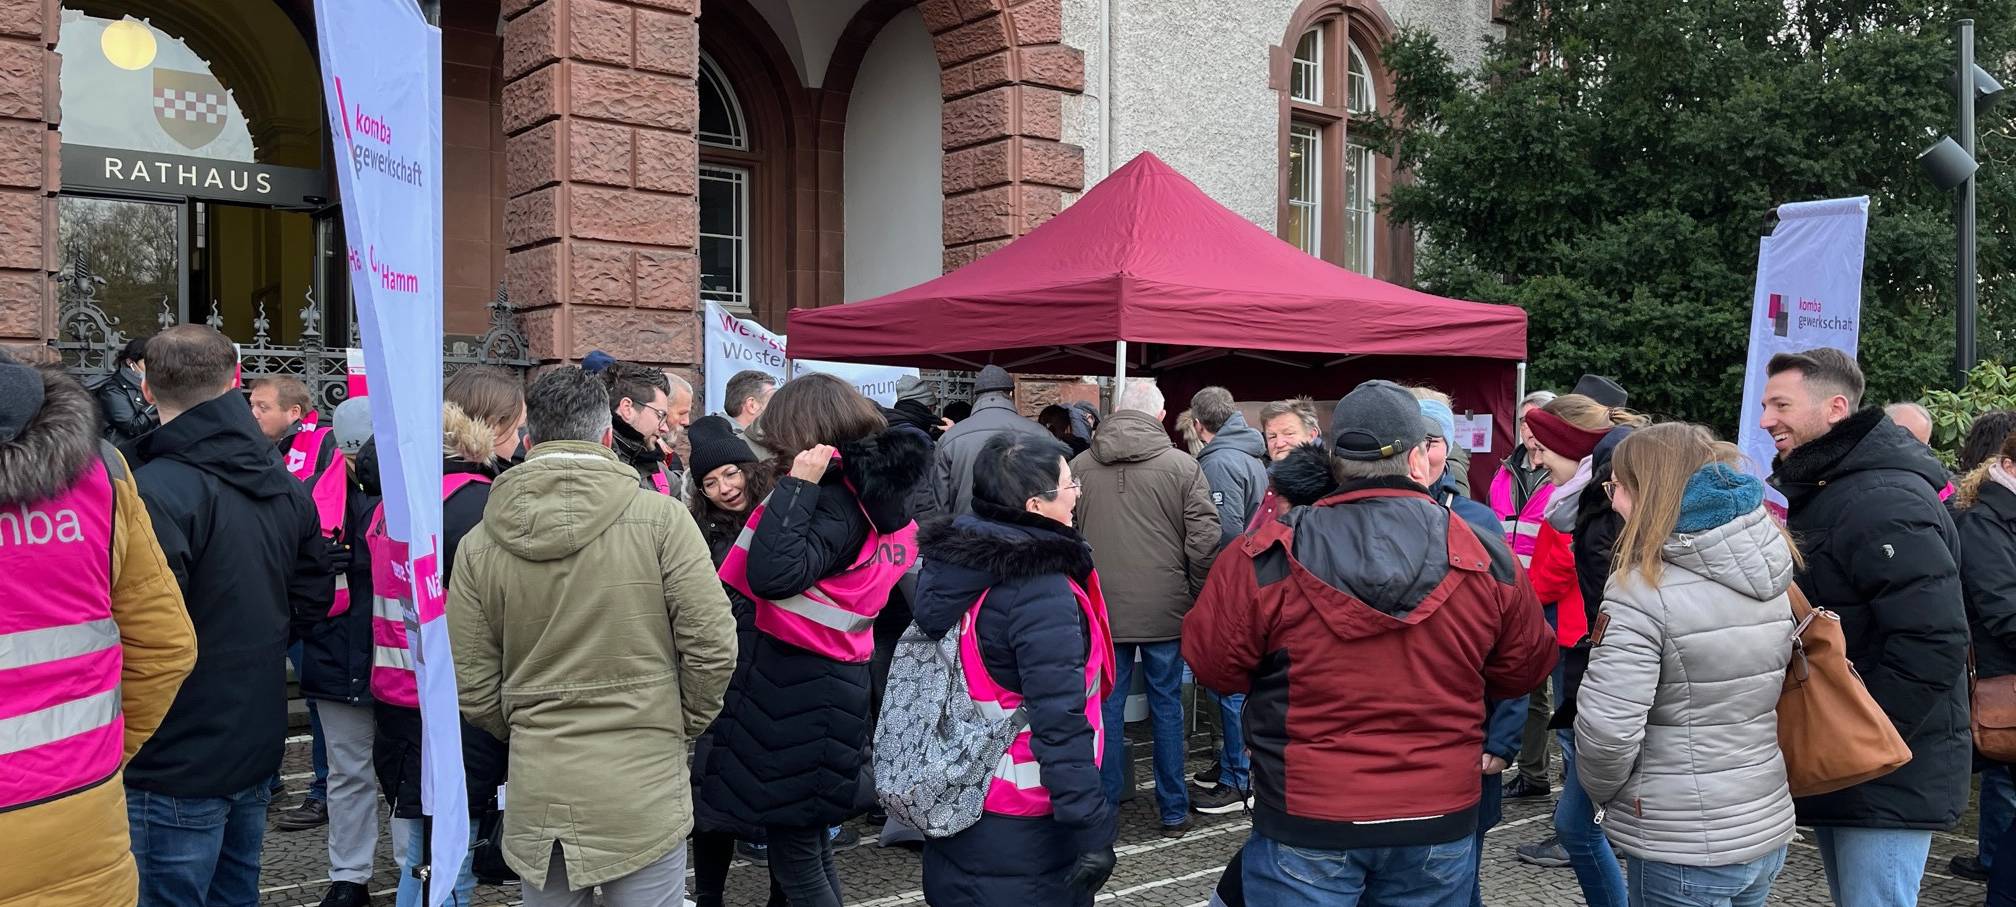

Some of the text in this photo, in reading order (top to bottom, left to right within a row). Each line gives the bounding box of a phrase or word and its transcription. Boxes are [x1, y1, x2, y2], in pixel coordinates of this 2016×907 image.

[356, 104, 391, 145] komba
[105, 157, 271, 194] RATHAUS
[354, 143, 422, 187] gewerkschaft
[381, 263, 418, 293] Hamm
[1799, 296, 1822, 313] komba
